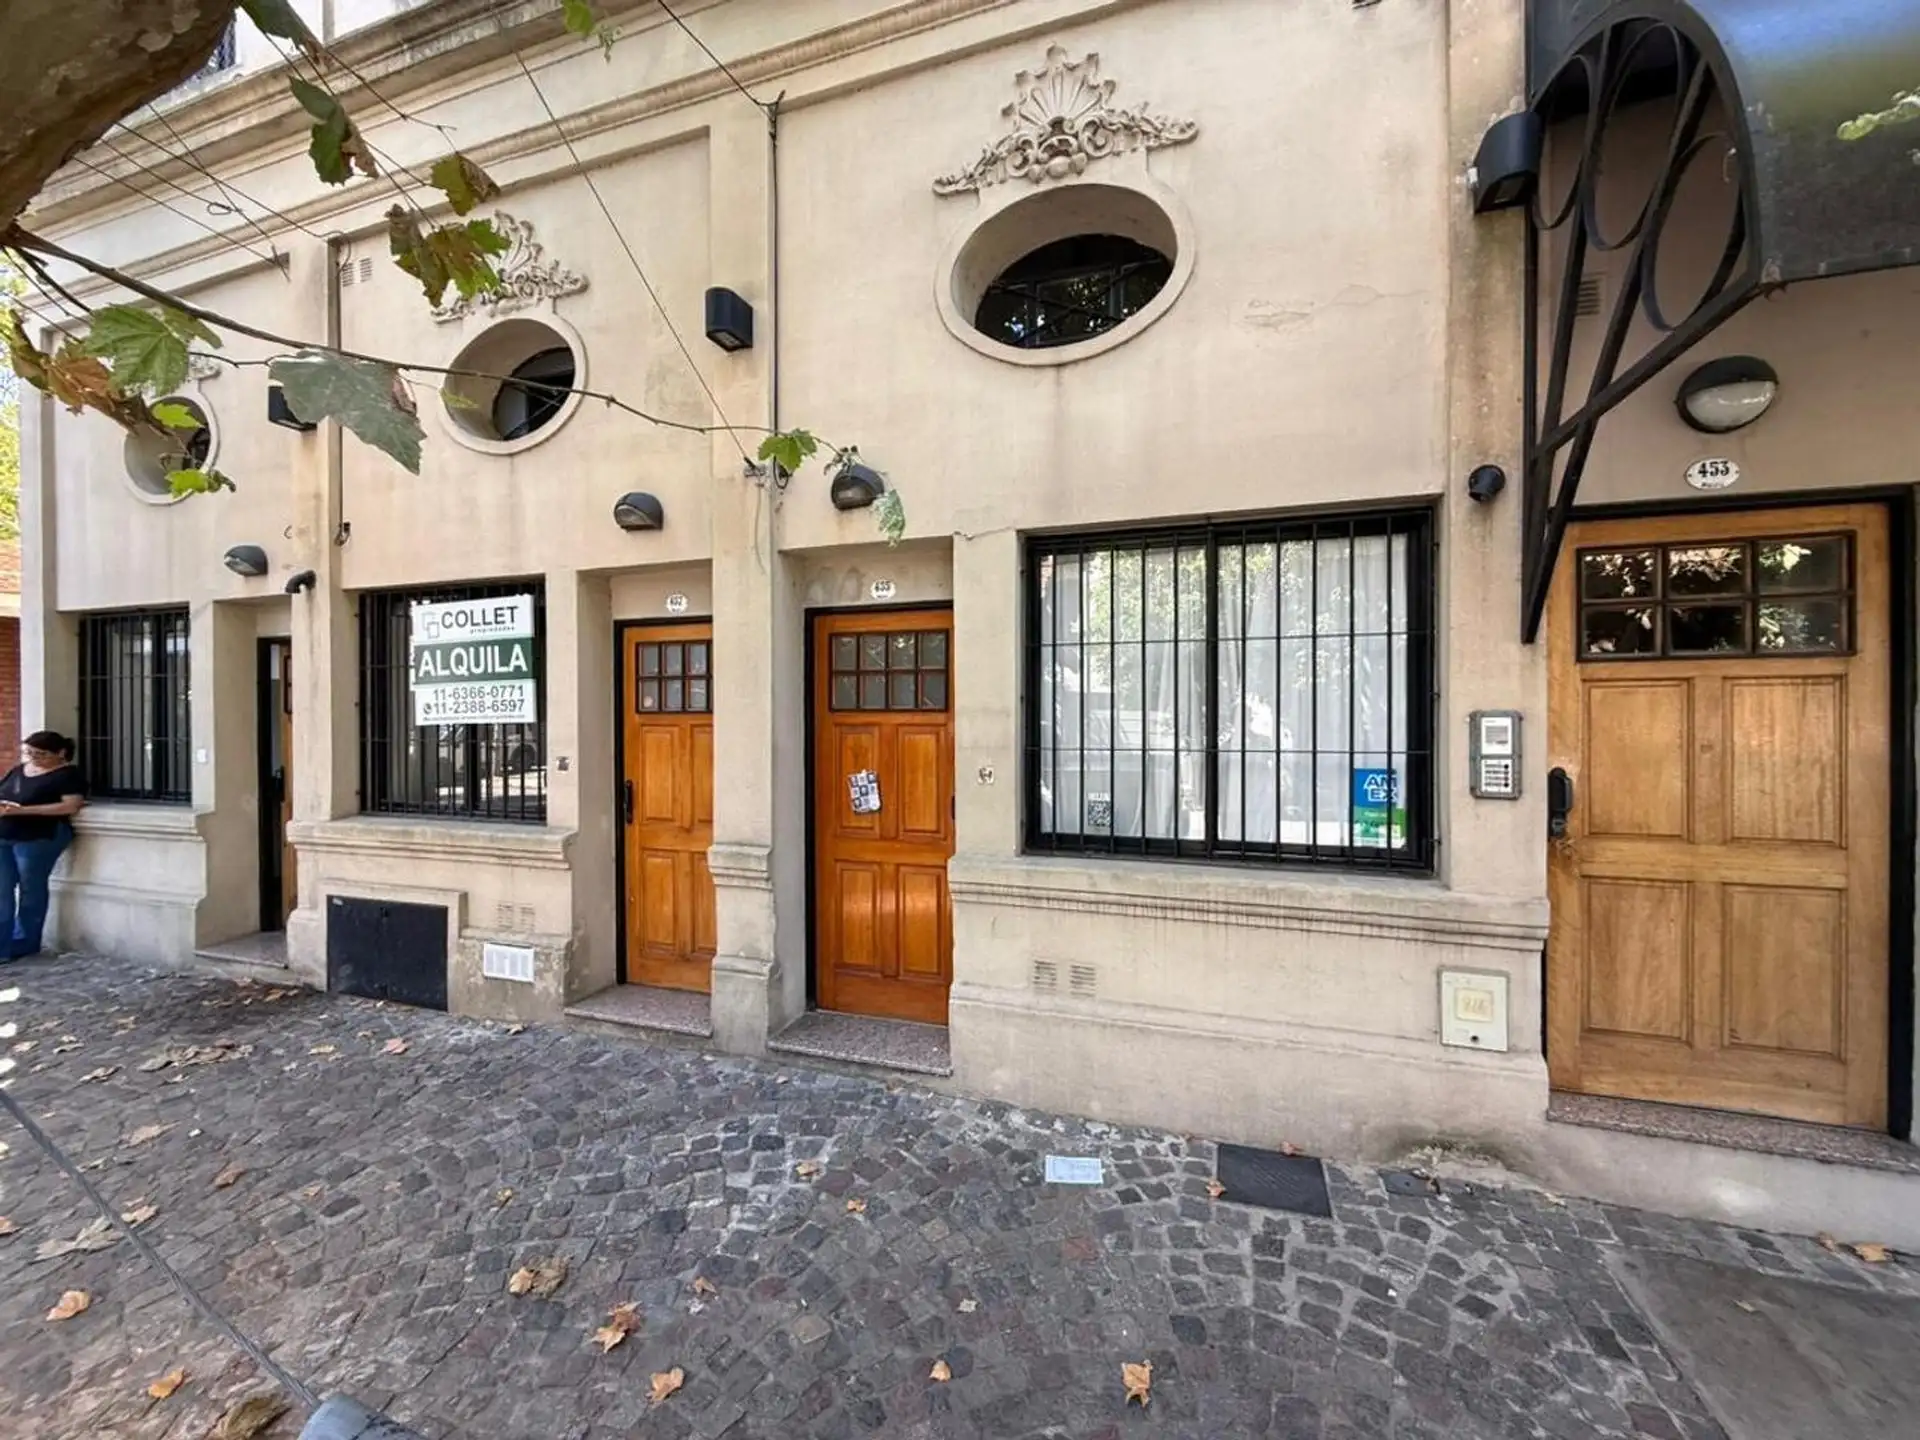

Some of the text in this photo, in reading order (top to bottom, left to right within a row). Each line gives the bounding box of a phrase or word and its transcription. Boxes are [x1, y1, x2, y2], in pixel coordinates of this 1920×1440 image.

[1698, 461, 1729, 478] 453
[441, 606, 519, 629] COLLET
[418, 643, 528, 677] ALQUILA
[433, 685, 524, 701] 11-6366-0771
[433, 699, 525, 715] 11-2388-6597
